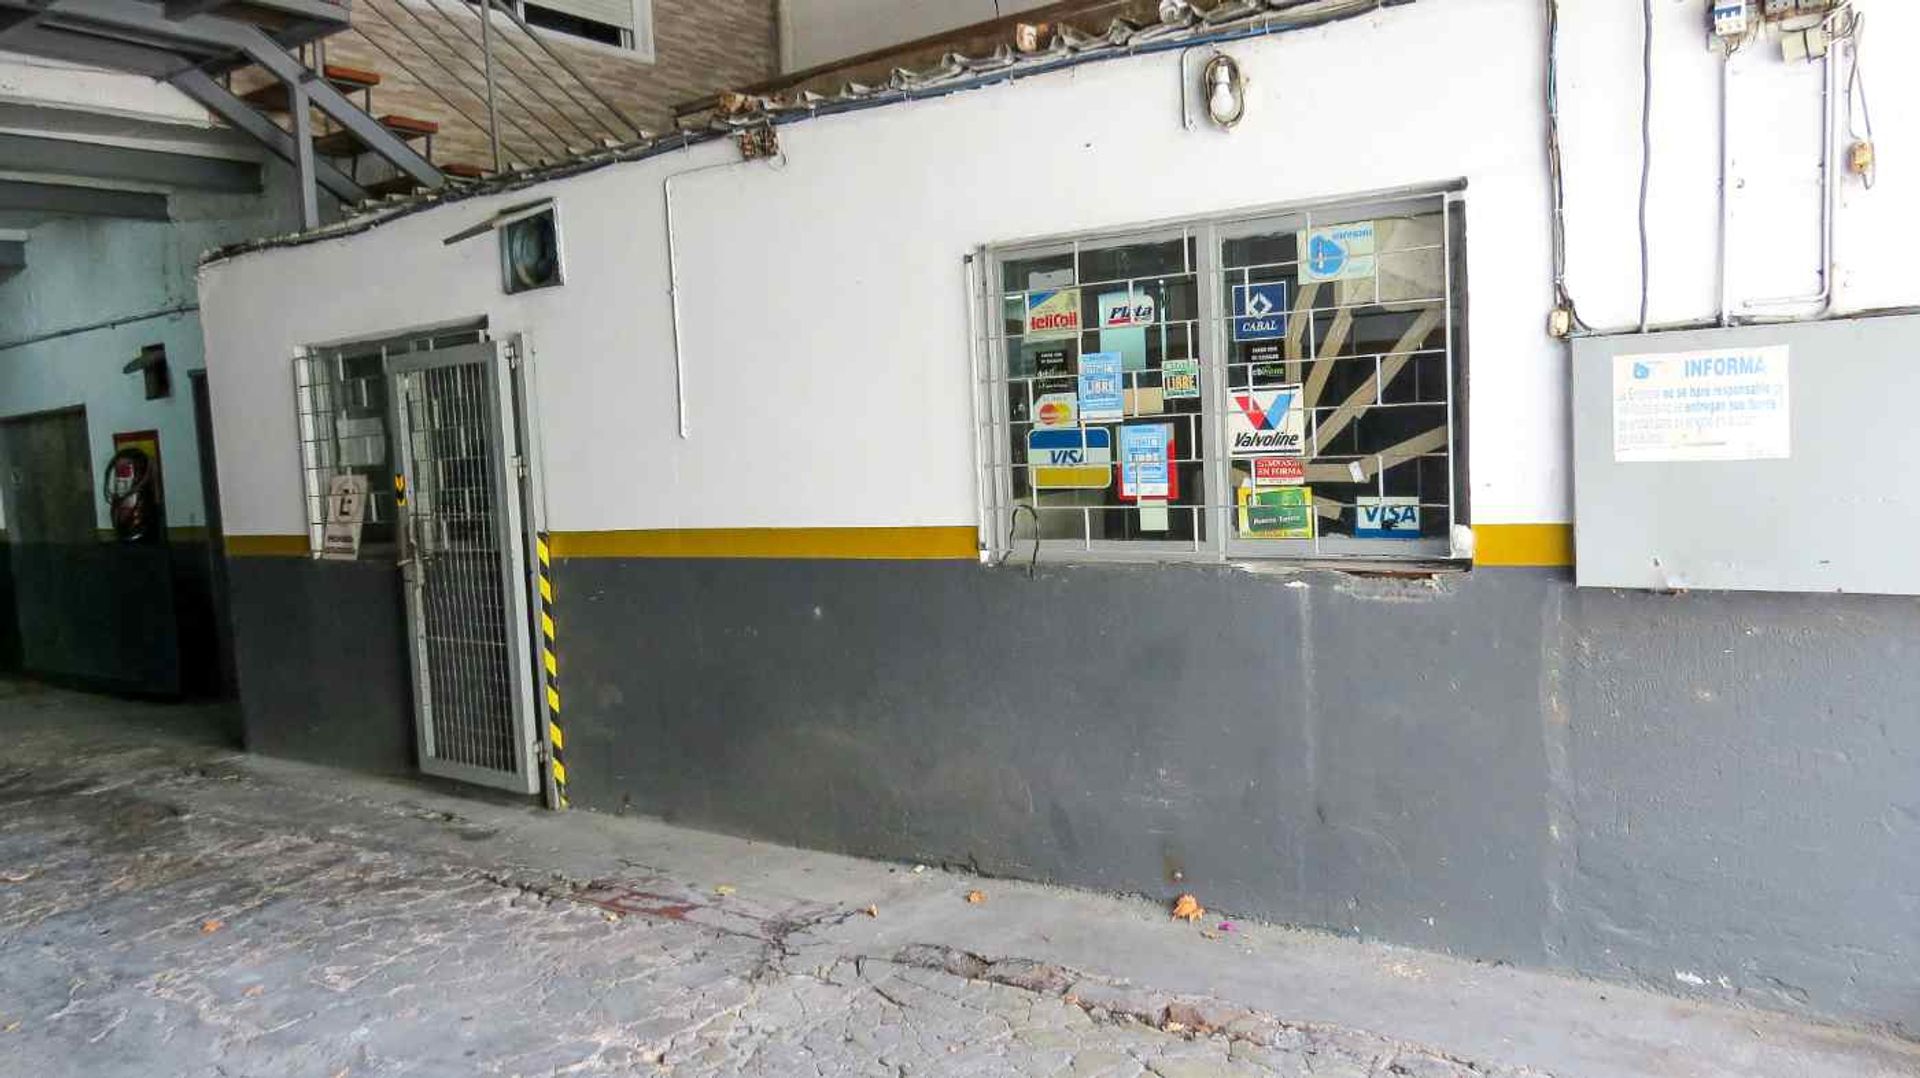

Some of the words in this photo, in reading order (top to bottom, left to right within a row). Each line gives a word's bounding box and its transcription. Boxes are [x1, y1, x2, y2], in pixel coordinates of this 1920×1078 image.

[1242, 320, 1278, 332] CABAL
[1684, 357, 1766, 378] INFORMA
[1234, 431, 1299, 448] Valvoline
[1271, 467, 1304, 477] FORMA
[1363, 504, 1418, 524] VISA
